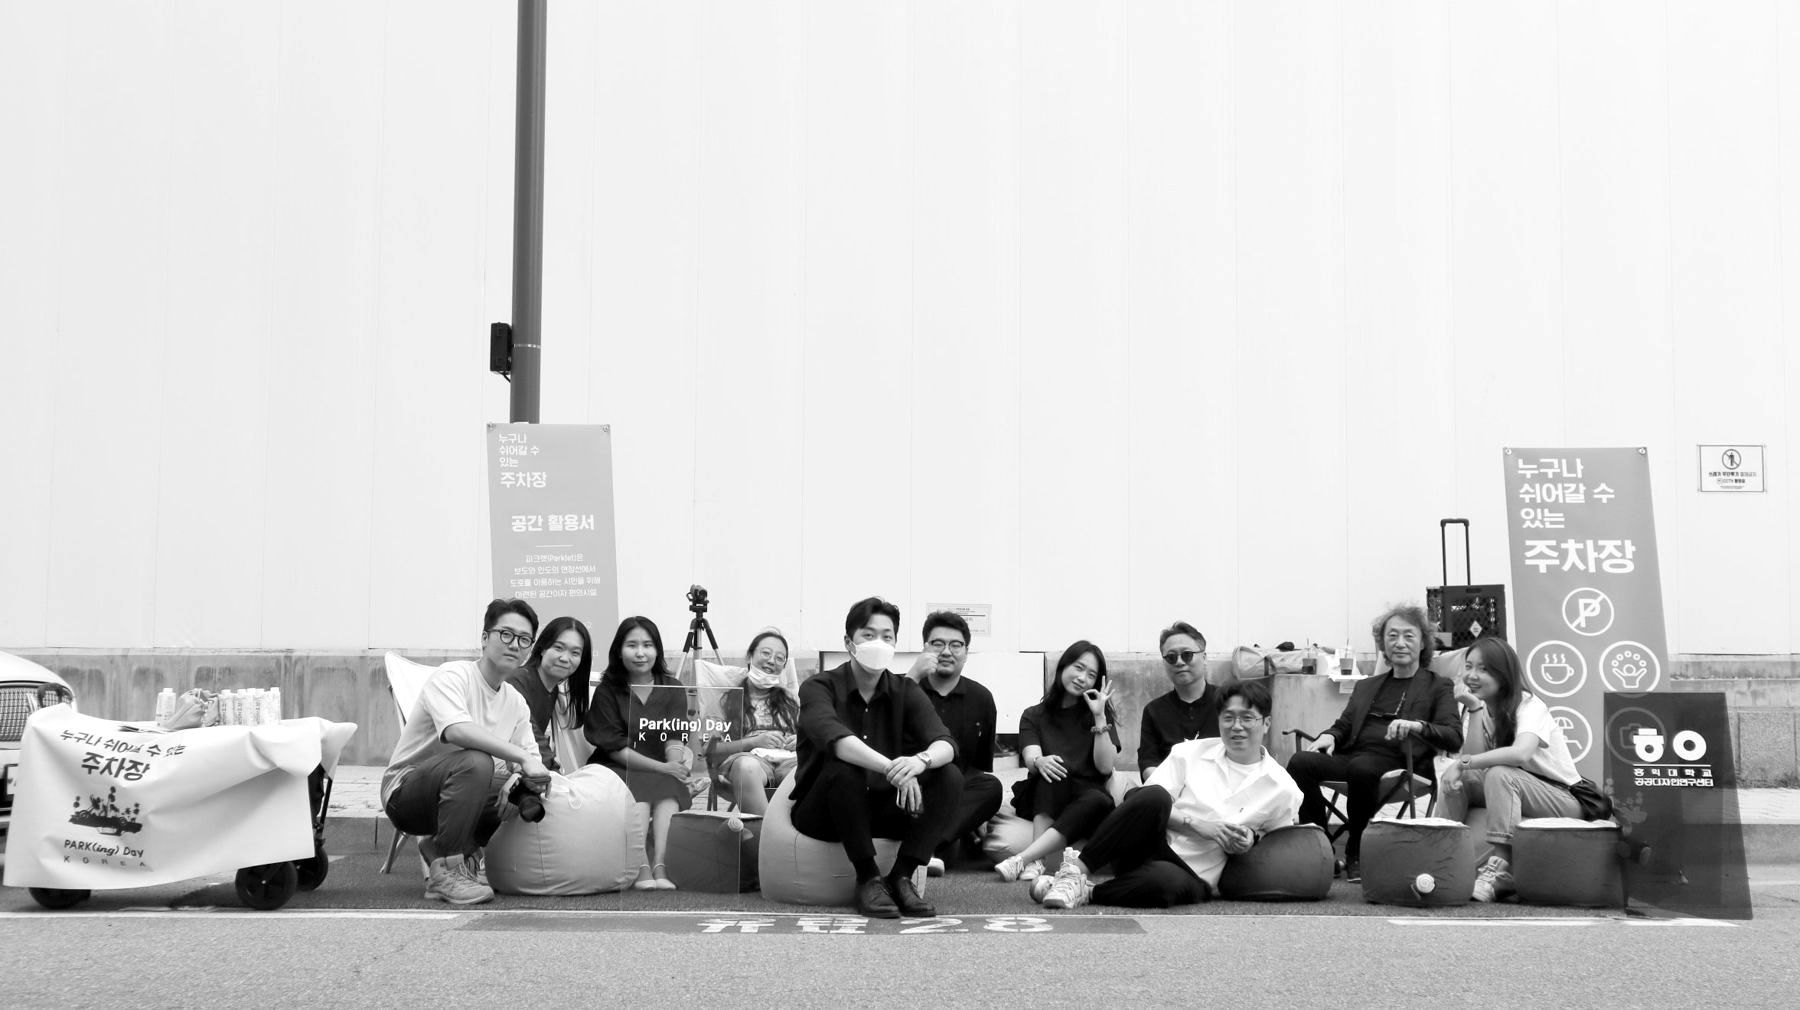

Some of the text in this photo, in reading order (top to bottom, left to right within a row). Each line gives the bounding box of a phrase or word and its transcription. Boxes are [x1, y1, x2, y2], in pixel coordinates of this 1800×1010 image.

[499, 433, 527, 444] 누구나
[499, 445, 540, 456] 쉬어갈 수
[499, 457, 519, 467] 있는
[1517, 458, 1584, 478] 누구나
[500, 471, 547, 488] 주차장
[1519, 483, 1615, 503] 쉬어갈 수
[511, 514, 595, 532] 공간 활용서
[1520, 507, 1565, 528] 있는
[1524, 539, 1636, 573] 주차장
[639, 718, 732, 732] Park(ing) Day
[60, 729, 102, 747] 누구나
[146, 744, 161, 757] 수
[638, 732, 732, 743] KOREA
[81, 751, 151, 781] 주차장
[1634, 778, 1714, 787] 공공디자인연구센터
[64, 839, 144, 858] PARK(ing) Day
[899, 917, 1055, 934] 28
